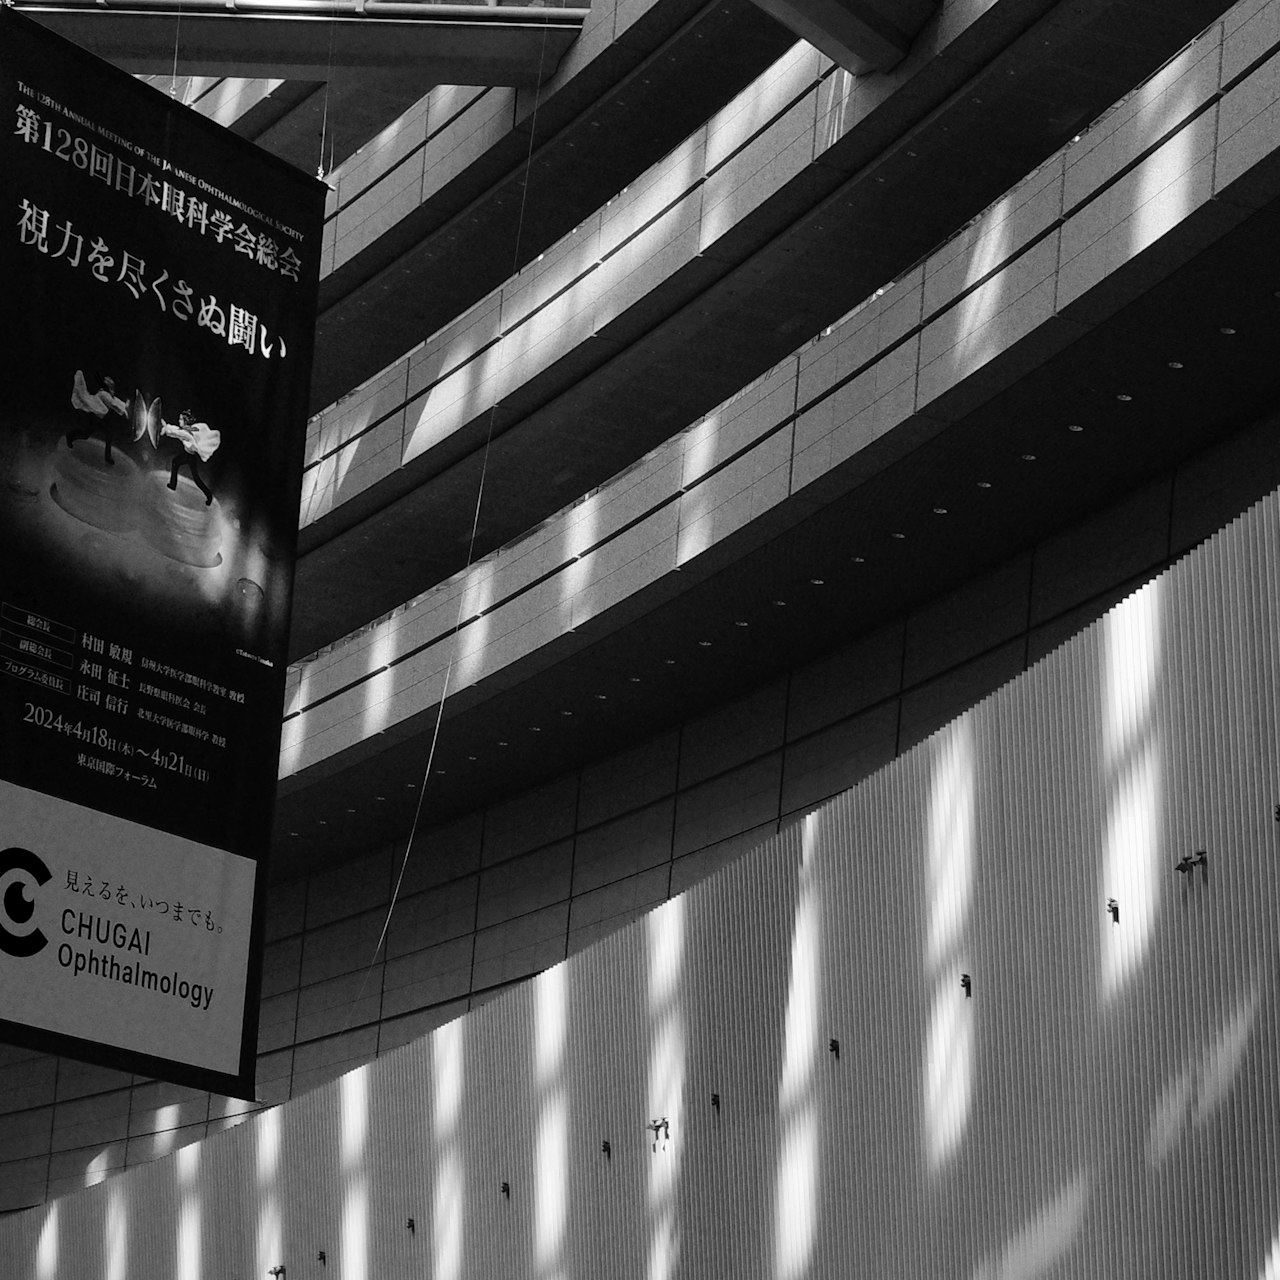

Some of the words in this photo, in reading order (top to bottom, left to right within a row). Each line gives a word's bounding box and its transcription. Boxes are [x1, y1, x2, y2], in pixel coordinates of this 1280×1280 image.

[17, 81, 35, 98] THE
[62, 106, 96, 131] ANNUAL
[97, 125, 134, 150] MEETING
[134, 145, 145, 157] OF
[146, 151, 161, 167] THE
[161, 159, 198, 186] JAANESE
[13, 103, 302, 283] 第128回日本眼科学会総会
[17, 198, 287, 359] 視力を尽くさぬ闘い
[76, 752, 158, 790] 東京国際フォーラム
[61, 908, 151, 956] CHUGAI
[64, 869, 223, 934] 見えるを、いつまでも。
[58, 943, 214, 1011] Ophthalmology
